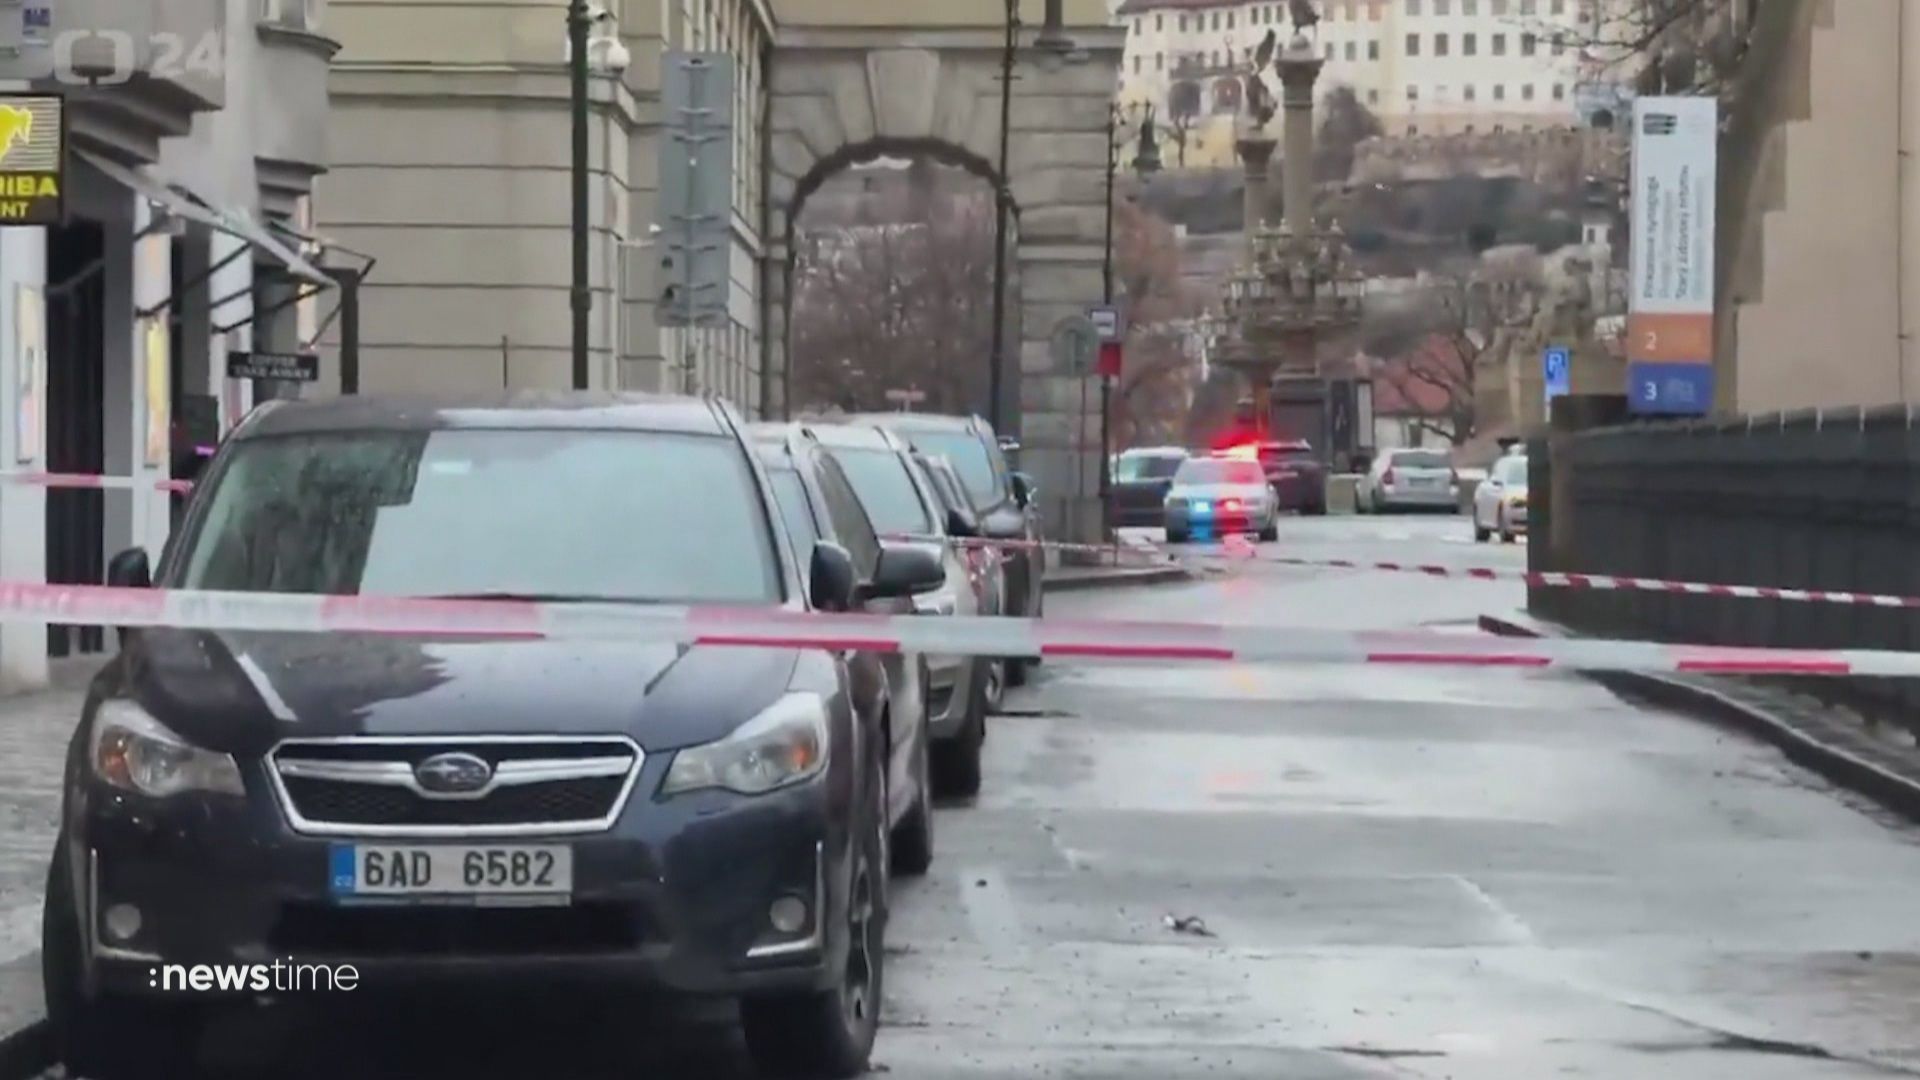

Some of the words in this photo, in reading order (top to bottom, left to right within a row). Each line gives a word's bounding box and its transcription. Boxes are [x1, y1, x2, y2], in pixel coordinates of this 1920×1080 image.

[1645, 380, 1658, 402] 3
[364, 851, 432, 887] 6AD
[463, 851, 555, 887] 6582
